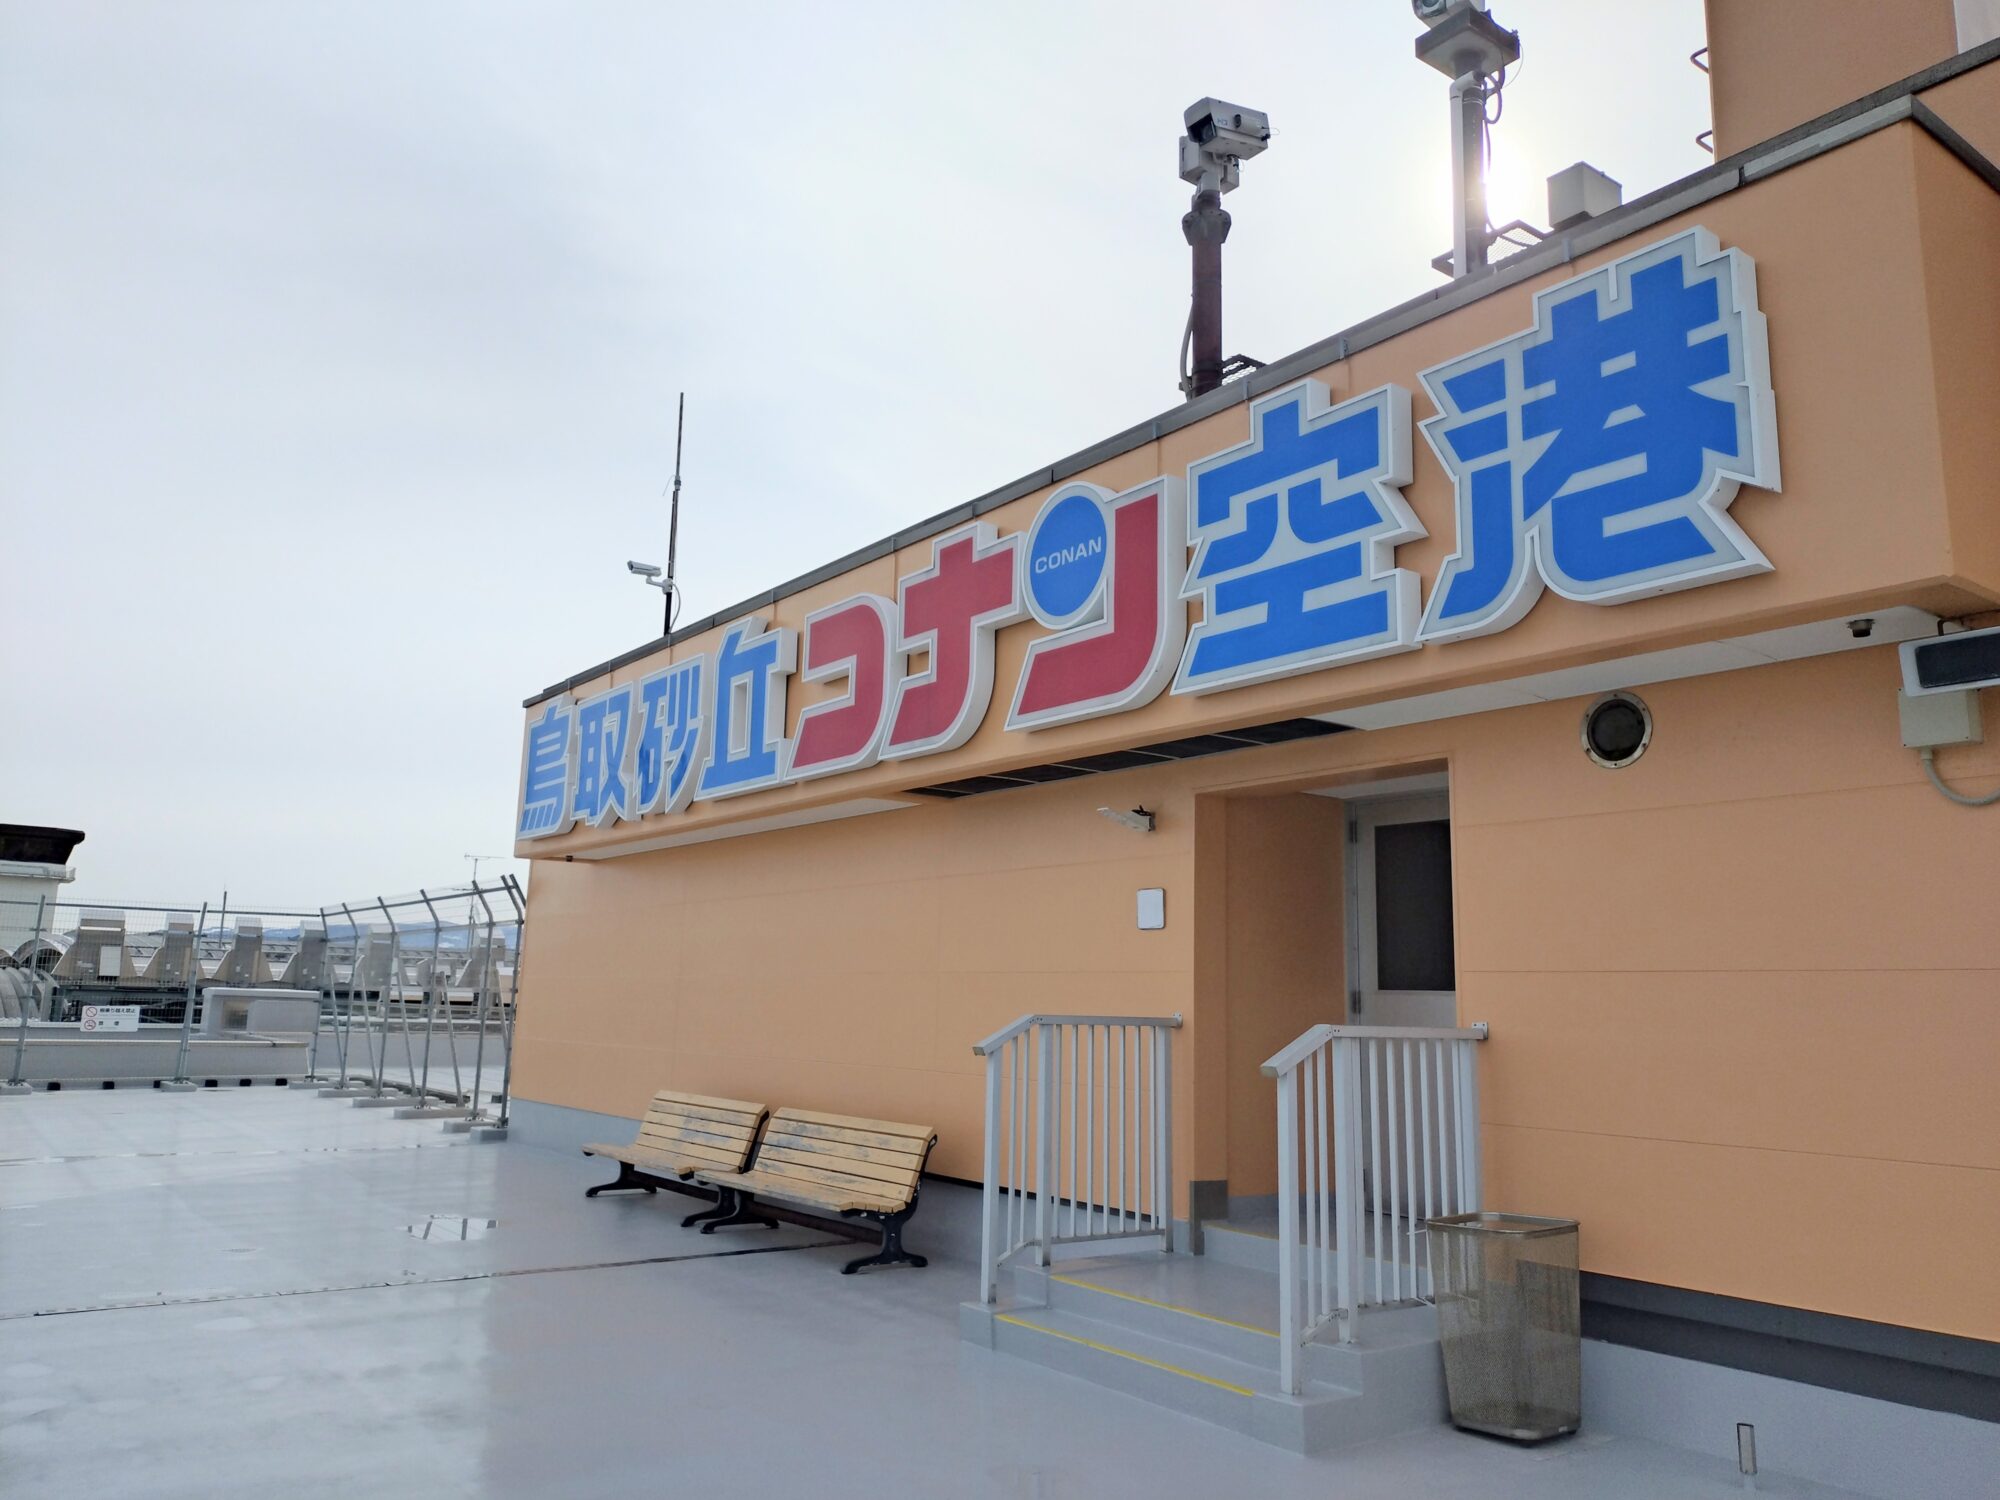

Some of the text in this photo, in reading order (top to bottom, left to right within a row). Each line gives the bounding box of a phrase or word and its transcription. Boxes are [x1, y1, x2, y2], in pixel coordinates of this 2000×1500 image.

[517, 230, 1765, 837] 鳥取砂丘コナン空港
[1034, 536, 1102, 574] CONAN
